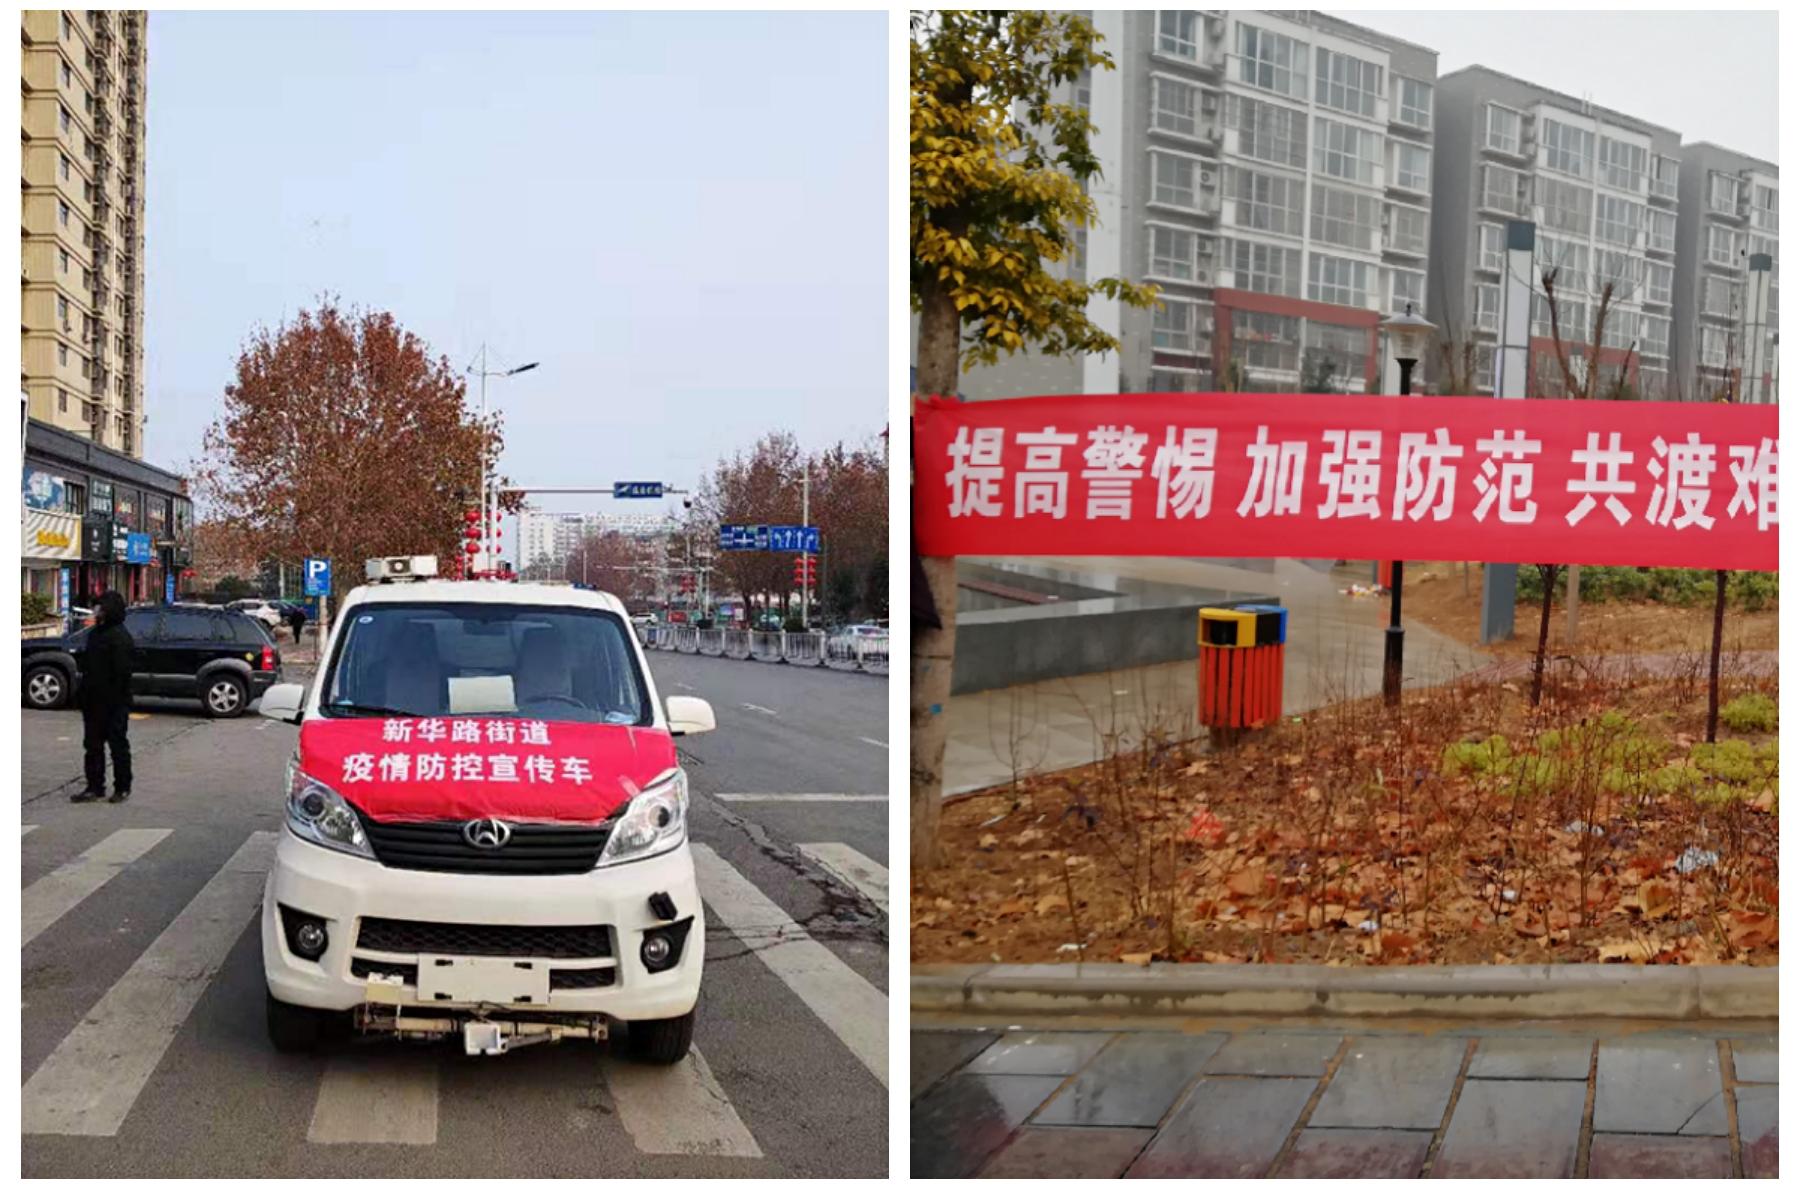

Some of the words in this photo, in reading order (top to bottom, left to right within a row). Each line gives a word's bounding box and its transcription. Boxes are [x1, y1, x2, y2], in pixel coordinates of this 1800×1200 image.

[946, 425, 1218, 520] 提高警惕
[1236, 425, 1542, 524] 加强防范
[1565, 432, 1779, 531] 共渡难
[309, 560, 327, 579] P
[382, 716, 551, 746] 新华路街道
[342, 752, 594, 785] 疫情防控宣传车
